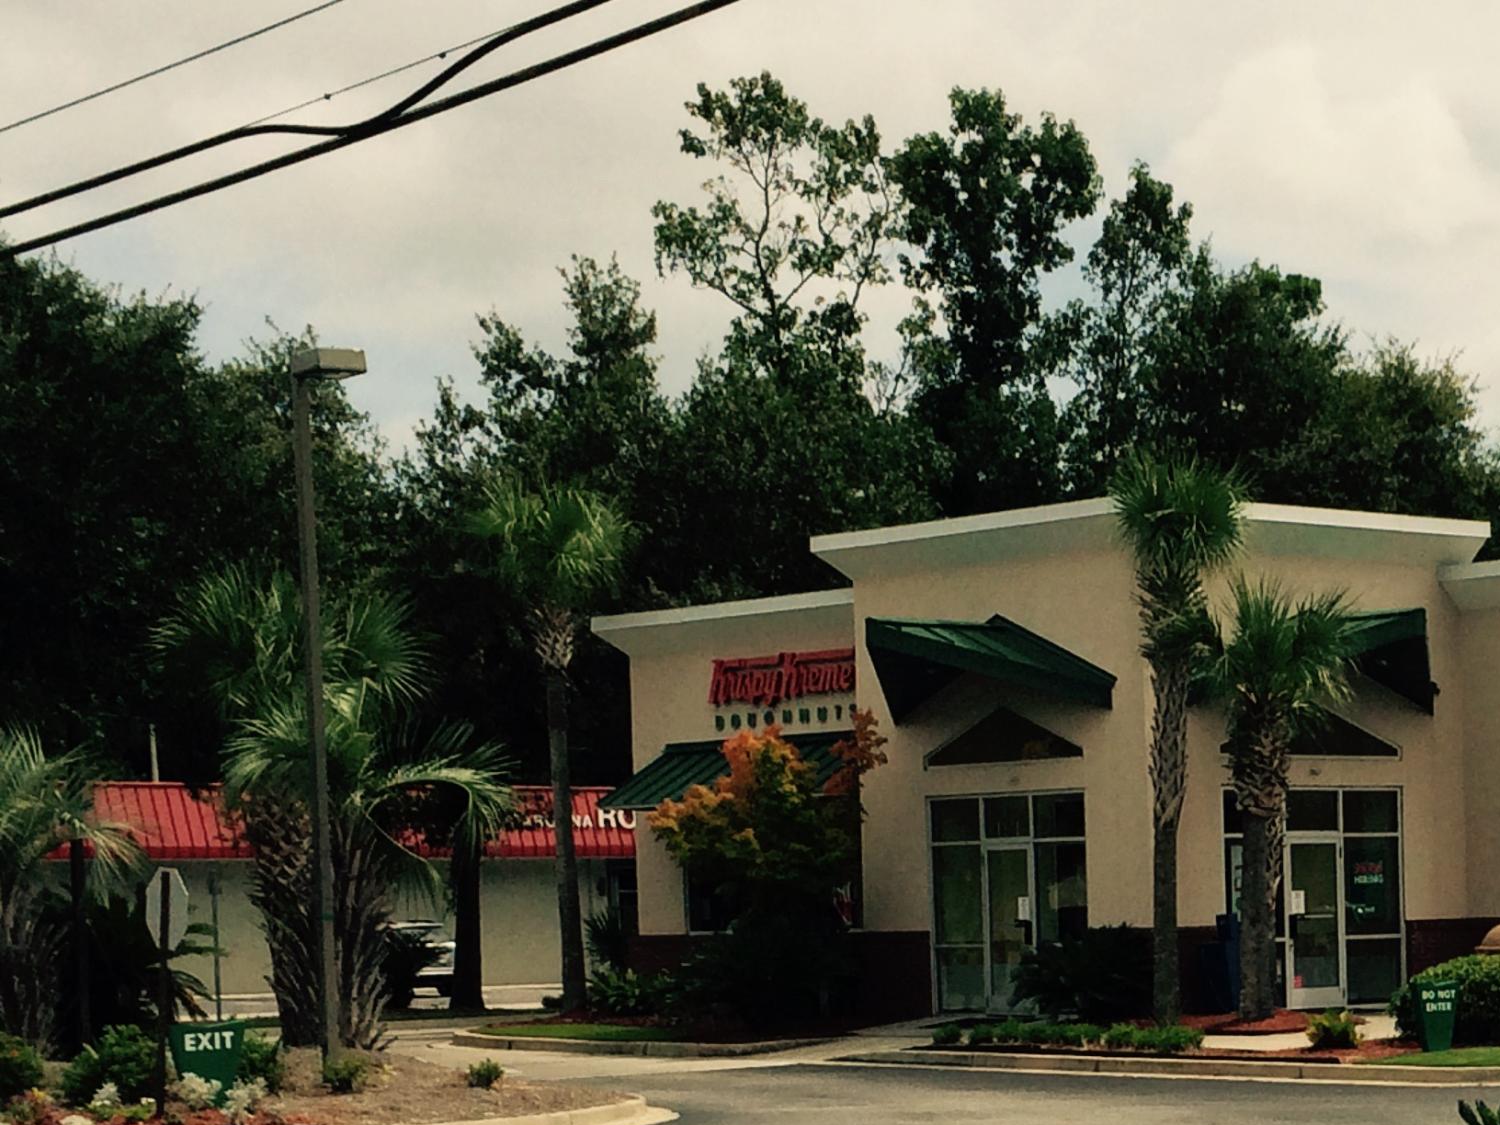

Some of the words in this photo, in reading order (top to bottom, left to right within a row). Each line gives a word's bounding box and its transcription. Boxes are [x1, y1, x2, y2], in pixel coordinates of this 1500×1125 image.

[708, 655, 780, 706] Krispy
[779, 648, 856, 698] Kreme
[1422, 990, 1435, 1000] DO
[1438, 989, 1456, 999] NOT
[1425, 1002, 1452, 1012] ENTER
[183, 1030, 235, 1052] EXIT
